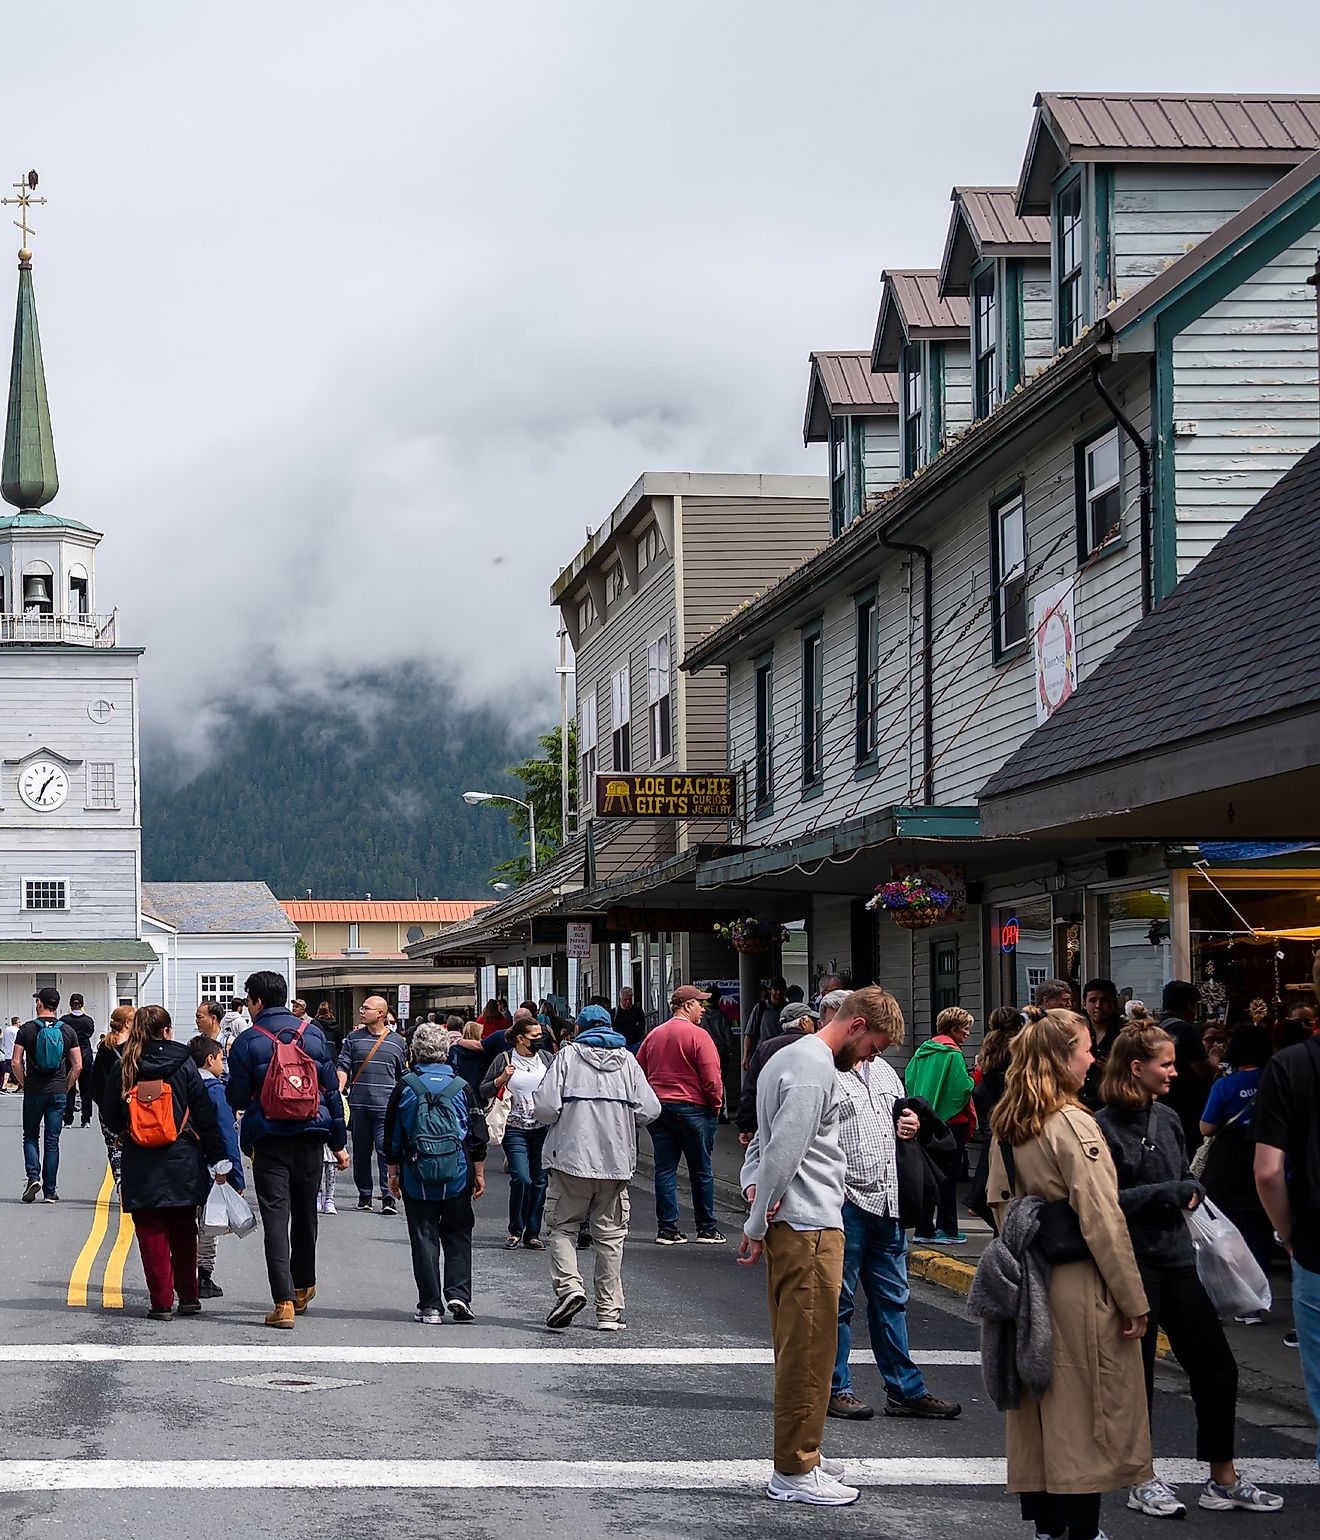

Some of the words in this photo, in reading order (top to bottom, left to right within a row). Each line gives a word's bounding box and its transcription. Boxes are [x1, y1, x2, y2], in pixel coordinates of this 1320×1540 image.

[634, 777, 665, 795] LOG
[671, 777, 731, 795] CACHE
[636, 796, 688, 814] GIFTS
[692, 795, 728, 805] CURIOS
[692, 805, 732, 814] JEWELRY
